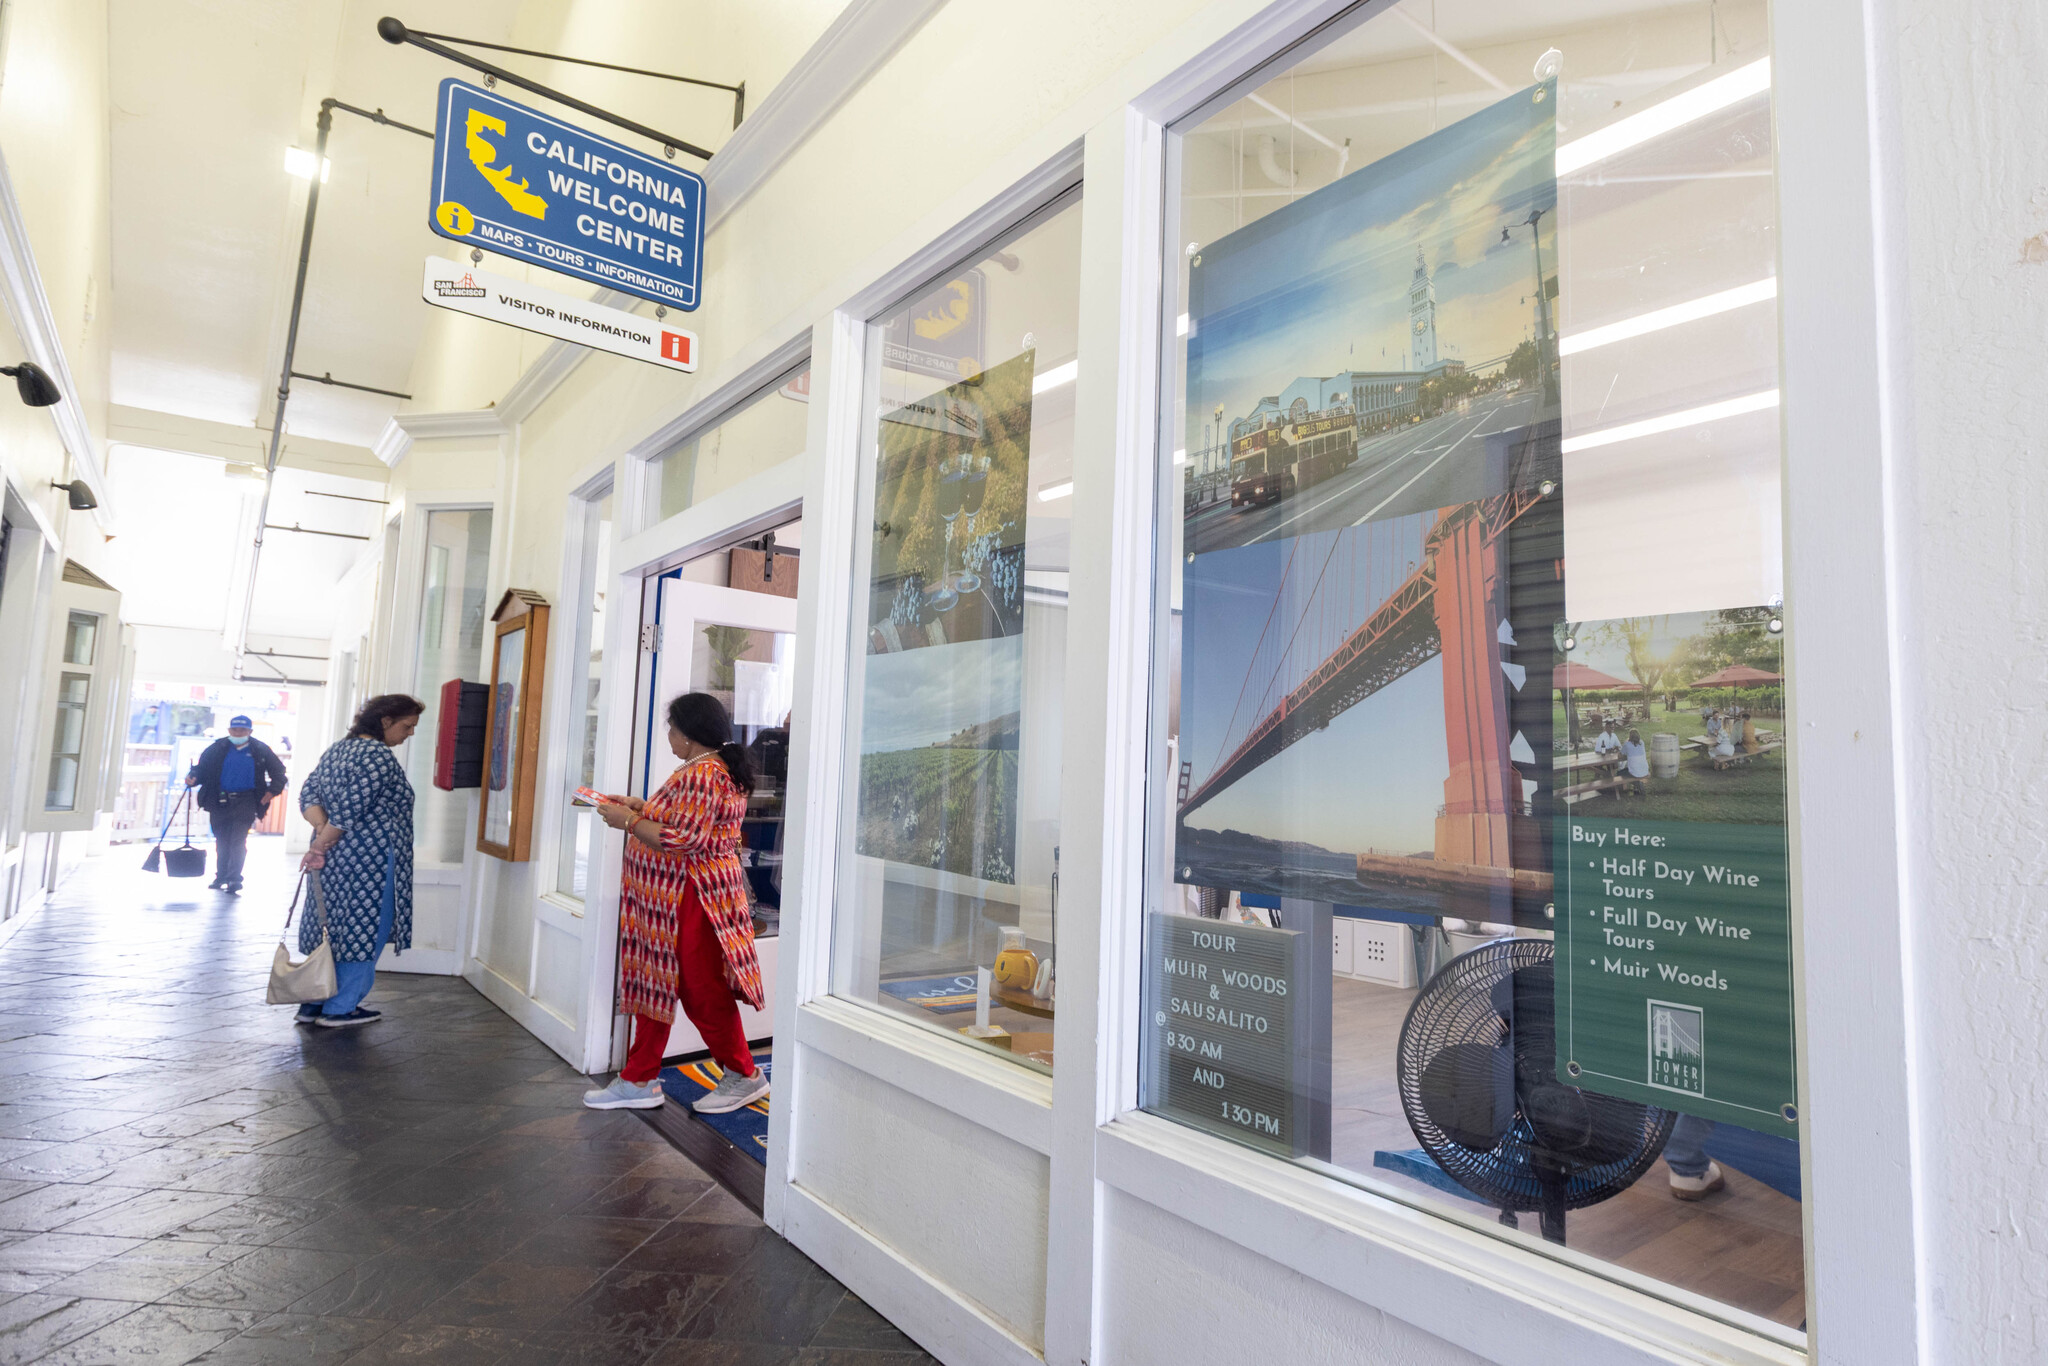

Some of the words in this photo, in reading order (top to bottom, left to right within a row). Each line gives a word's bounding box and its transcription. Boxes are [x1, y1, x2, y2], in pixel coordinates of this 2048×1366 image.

[527, 131, 687, 209] CALIFORNIA
[547, 169, 686, 238] WELCOME
[576, 214, 683, 267] CENTER
[481, 224, 524, 248] MAPS
[536, 242, 585, 267] TOURS
[595, 260, 684, 299] INFORMATION
[435, 281, 453, 289] SAN
[440, 288, 485, 297] FRANCISCO
[498, 294, 555, 318] VISITOR
[558, 310, 652, 345] INFORMATION
[1572, 825, 1607, 847] Buy
[1614, 828, 1666, 848] Here:
[1602, 857, 1647, 878] Half
[1654, 861, 1695, 885] Day
[1702, 865, 1760, 887] Wine
[1602, 879, 1654, 900] Tours
[1603, 906, 1638, 927] Full
[1646, 911, 1687, 936] Day
[1695, 916, 1752, 940] Wine
[1191, 930, 1236, 952] TOUR
[1603, 928, 1655, 951] Tours
[1164, 957, 1208, 981] MUIR
[1221, 968, 1287, 996] WOODS
[1603, 955, 1649, 979] Muir
[1657, 963, 1728, 991] Woods
[1209, 984, 1220, 1001] &
[1155, 1010, 1166, 1026] @
[1170, 997, 1268, 1034] SAUSALITO
[1200, 1041, 1223, 1061] AM
[1193, 1066, 1225, 1090] AND
[1655, 1059, 1698, 1080] TOWER
[1655, 1072, 1698, 1091] TOURS
[1255, 1113, 1279, 1136] PM
